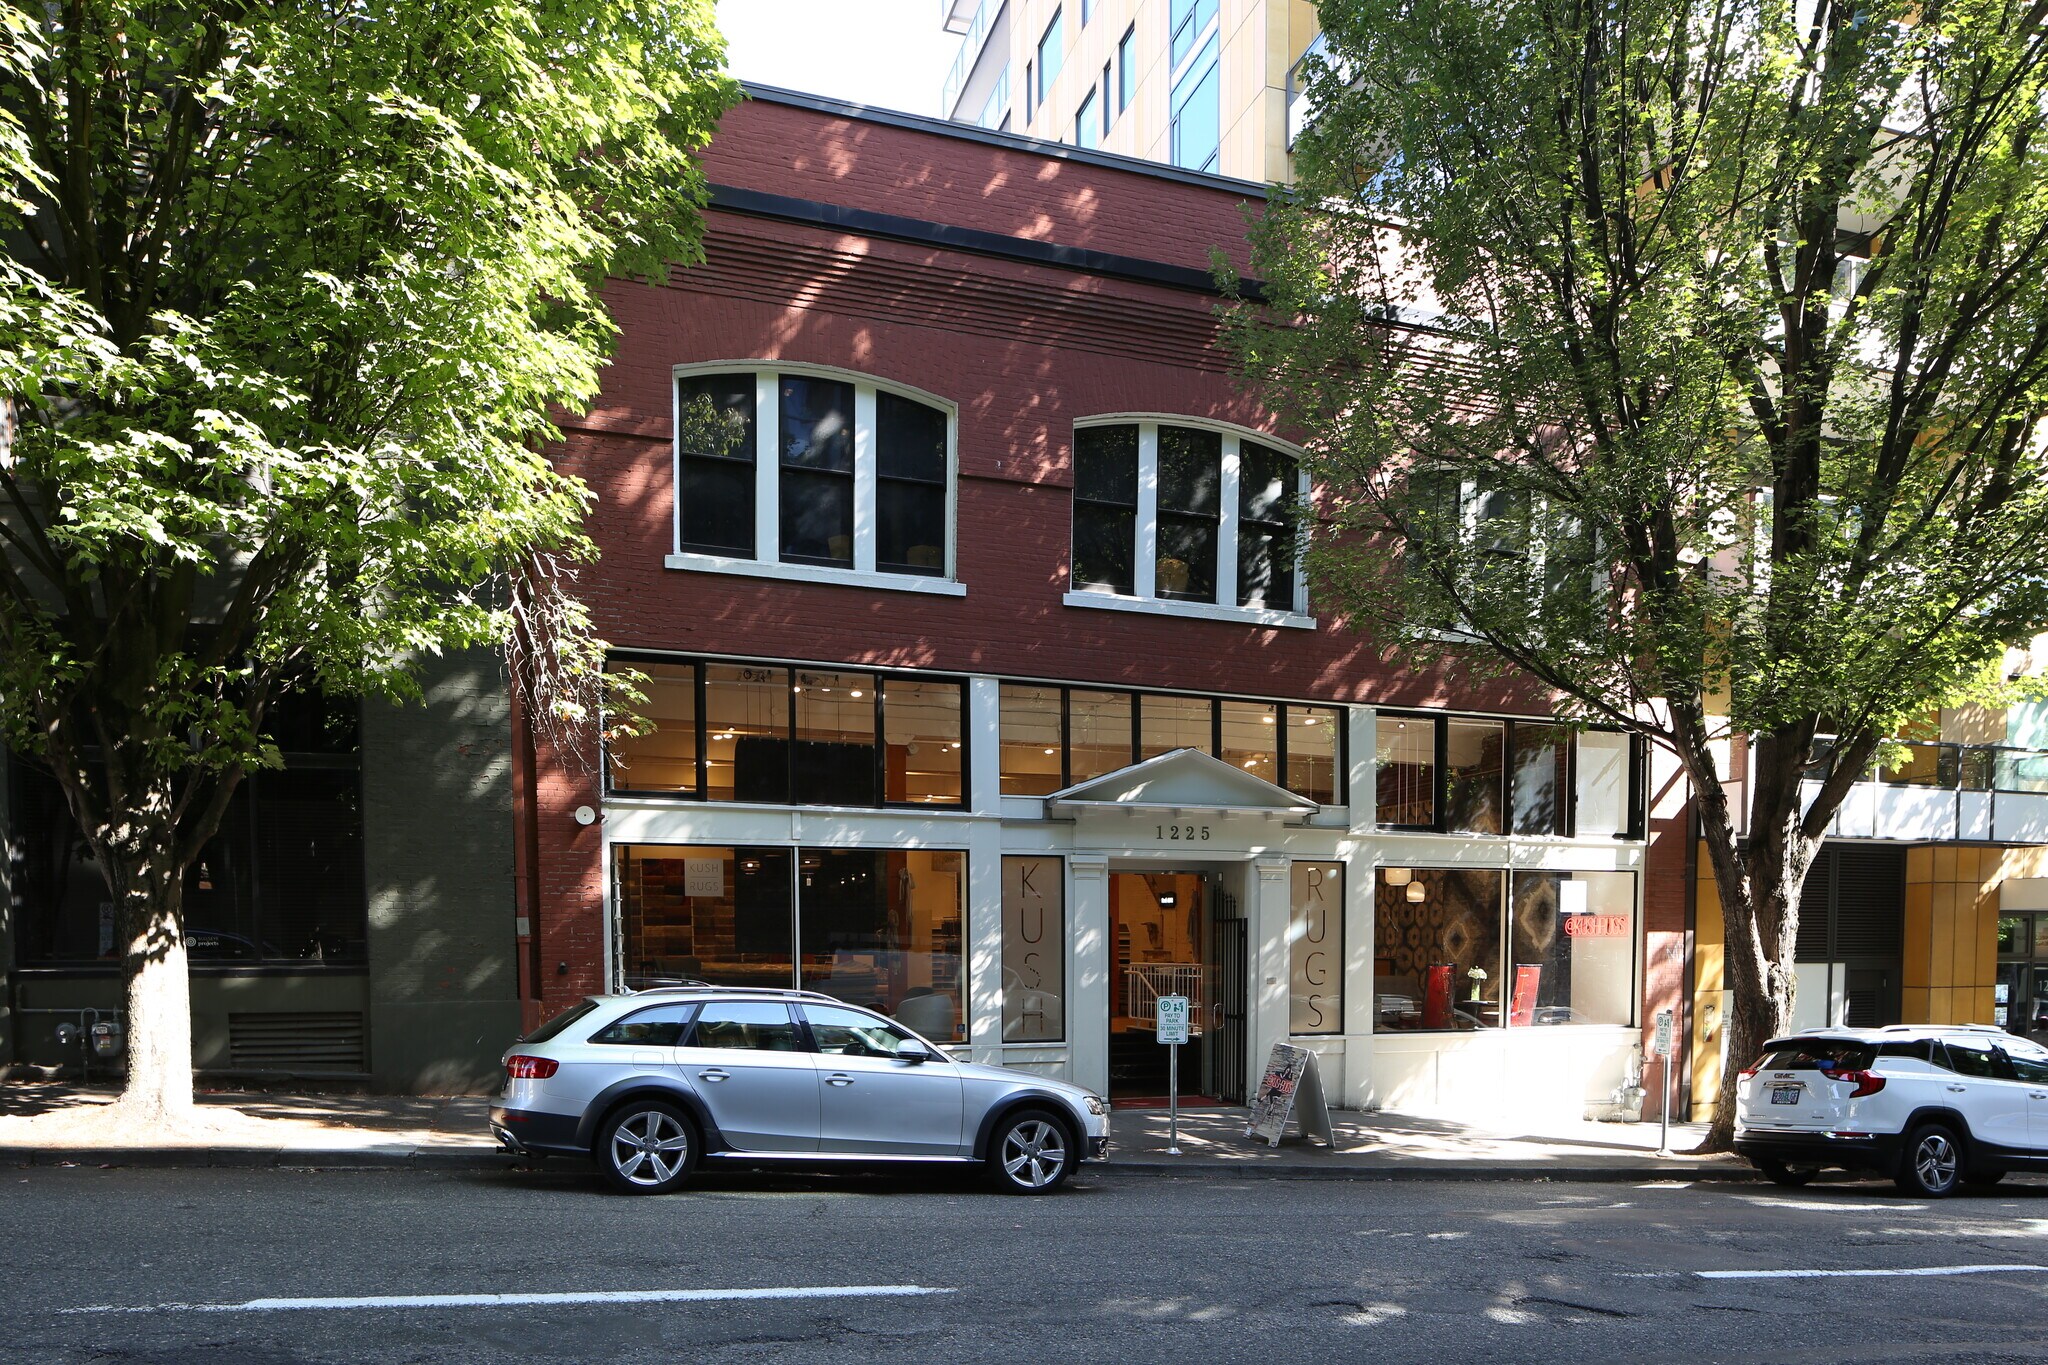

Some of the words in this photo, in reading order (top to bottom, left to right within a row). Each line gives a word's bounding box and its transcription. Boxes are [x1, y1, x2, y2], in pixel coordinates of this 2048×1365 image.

[1156, 825, 1210, 841] 1225
[689, 863, 719, 873] KUSH
[689, 881, 719, 892] RUGS
[1021, 862, 1043, 1034] KUSH
[1305, 867, 1327, 1029] RUGS
